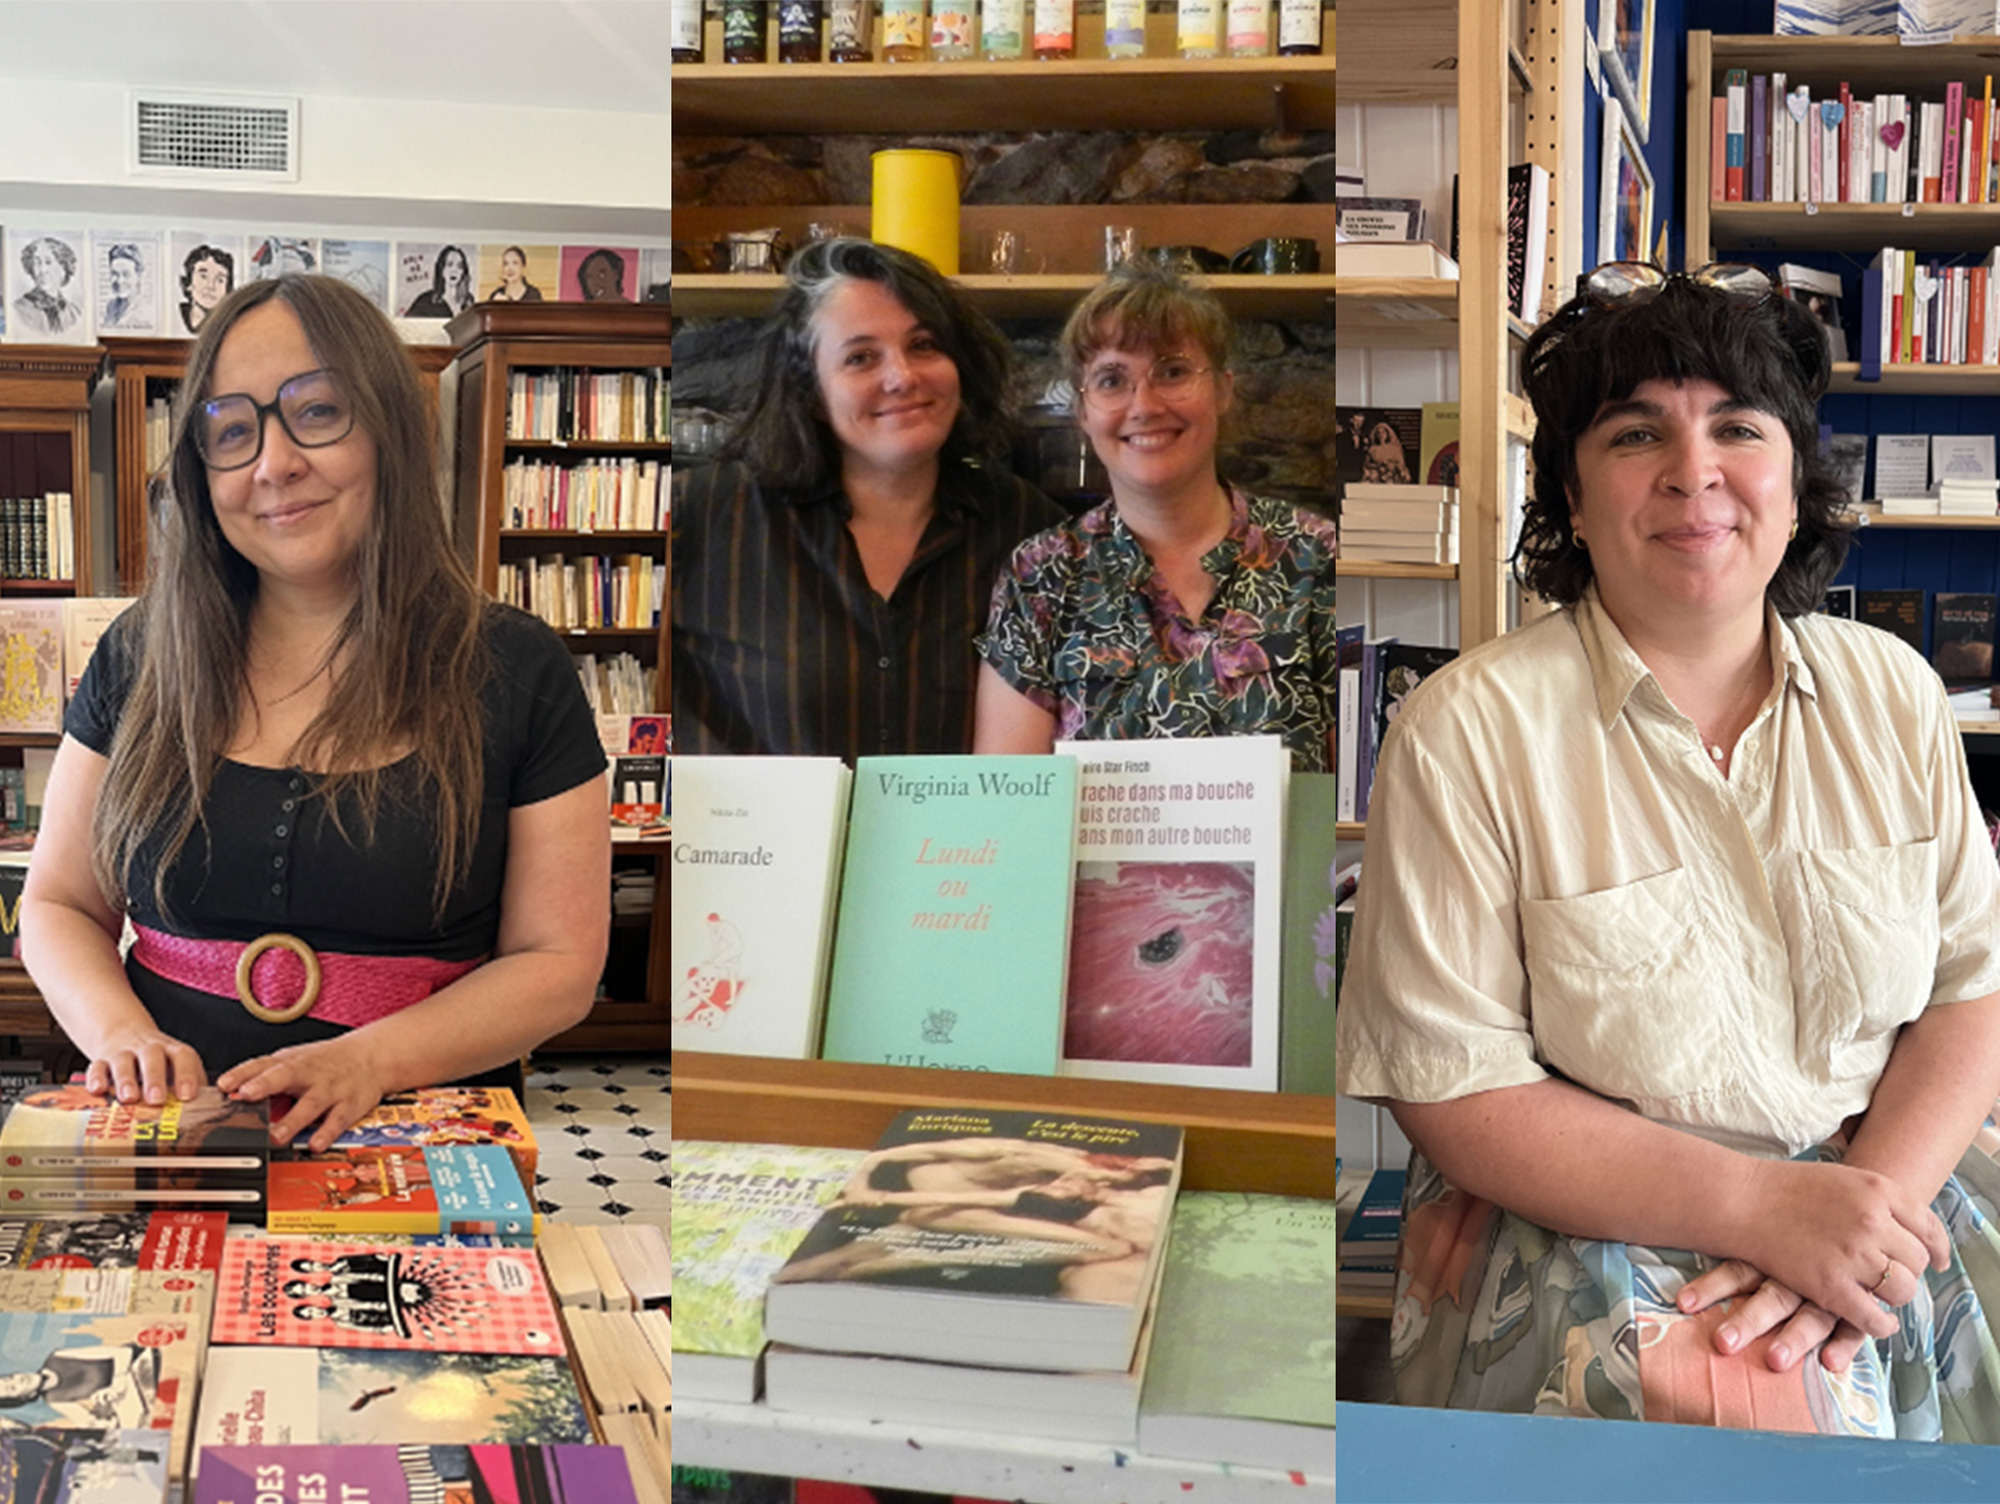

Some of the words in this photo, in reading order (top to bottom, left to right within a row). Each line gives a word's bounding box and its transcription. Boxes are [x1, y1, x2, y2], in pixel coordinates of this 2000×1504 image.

[1082, 762, 1101, 774] aire
[1103, 761, 1122, 773] Star
[1124, 760, 1150, 773] Finch
[879, 773, 970, 804] Virginia
[978, 773, 1055, 797] Woolf
[1081, 783, 1125, 802] rache
[1128, 782, 1166, 802] dans
[1169, 784, 1192, 801] ma
[1196, 781, 1255, 801] bouche
[1080, 805, 1103, 823] uis
[1107, 804, 1160, 823] crache
[1079, 827, 1107, 845] ans
[1110, 827, 1144, 845] mon
[1148, 826, 1190, 845] autre
[1193, 825, 1252, 845] bouche
[674, 843, 774, 866] Camarade
[915, 838, 999, 865] Lundi
[938, 879, 969, 897] ou
[911, 905, 992, 932] mardi
[912, 1114, 990, 1126] Mariana
[1031, 1119, 1056, 1129] La
[1070, 1131, 1088, 1142] le
[1088, 1132, 1130, 1145] pire
[256, 1312, 277, 1337] Les
[216, 1412, 240, 1446] rielle
